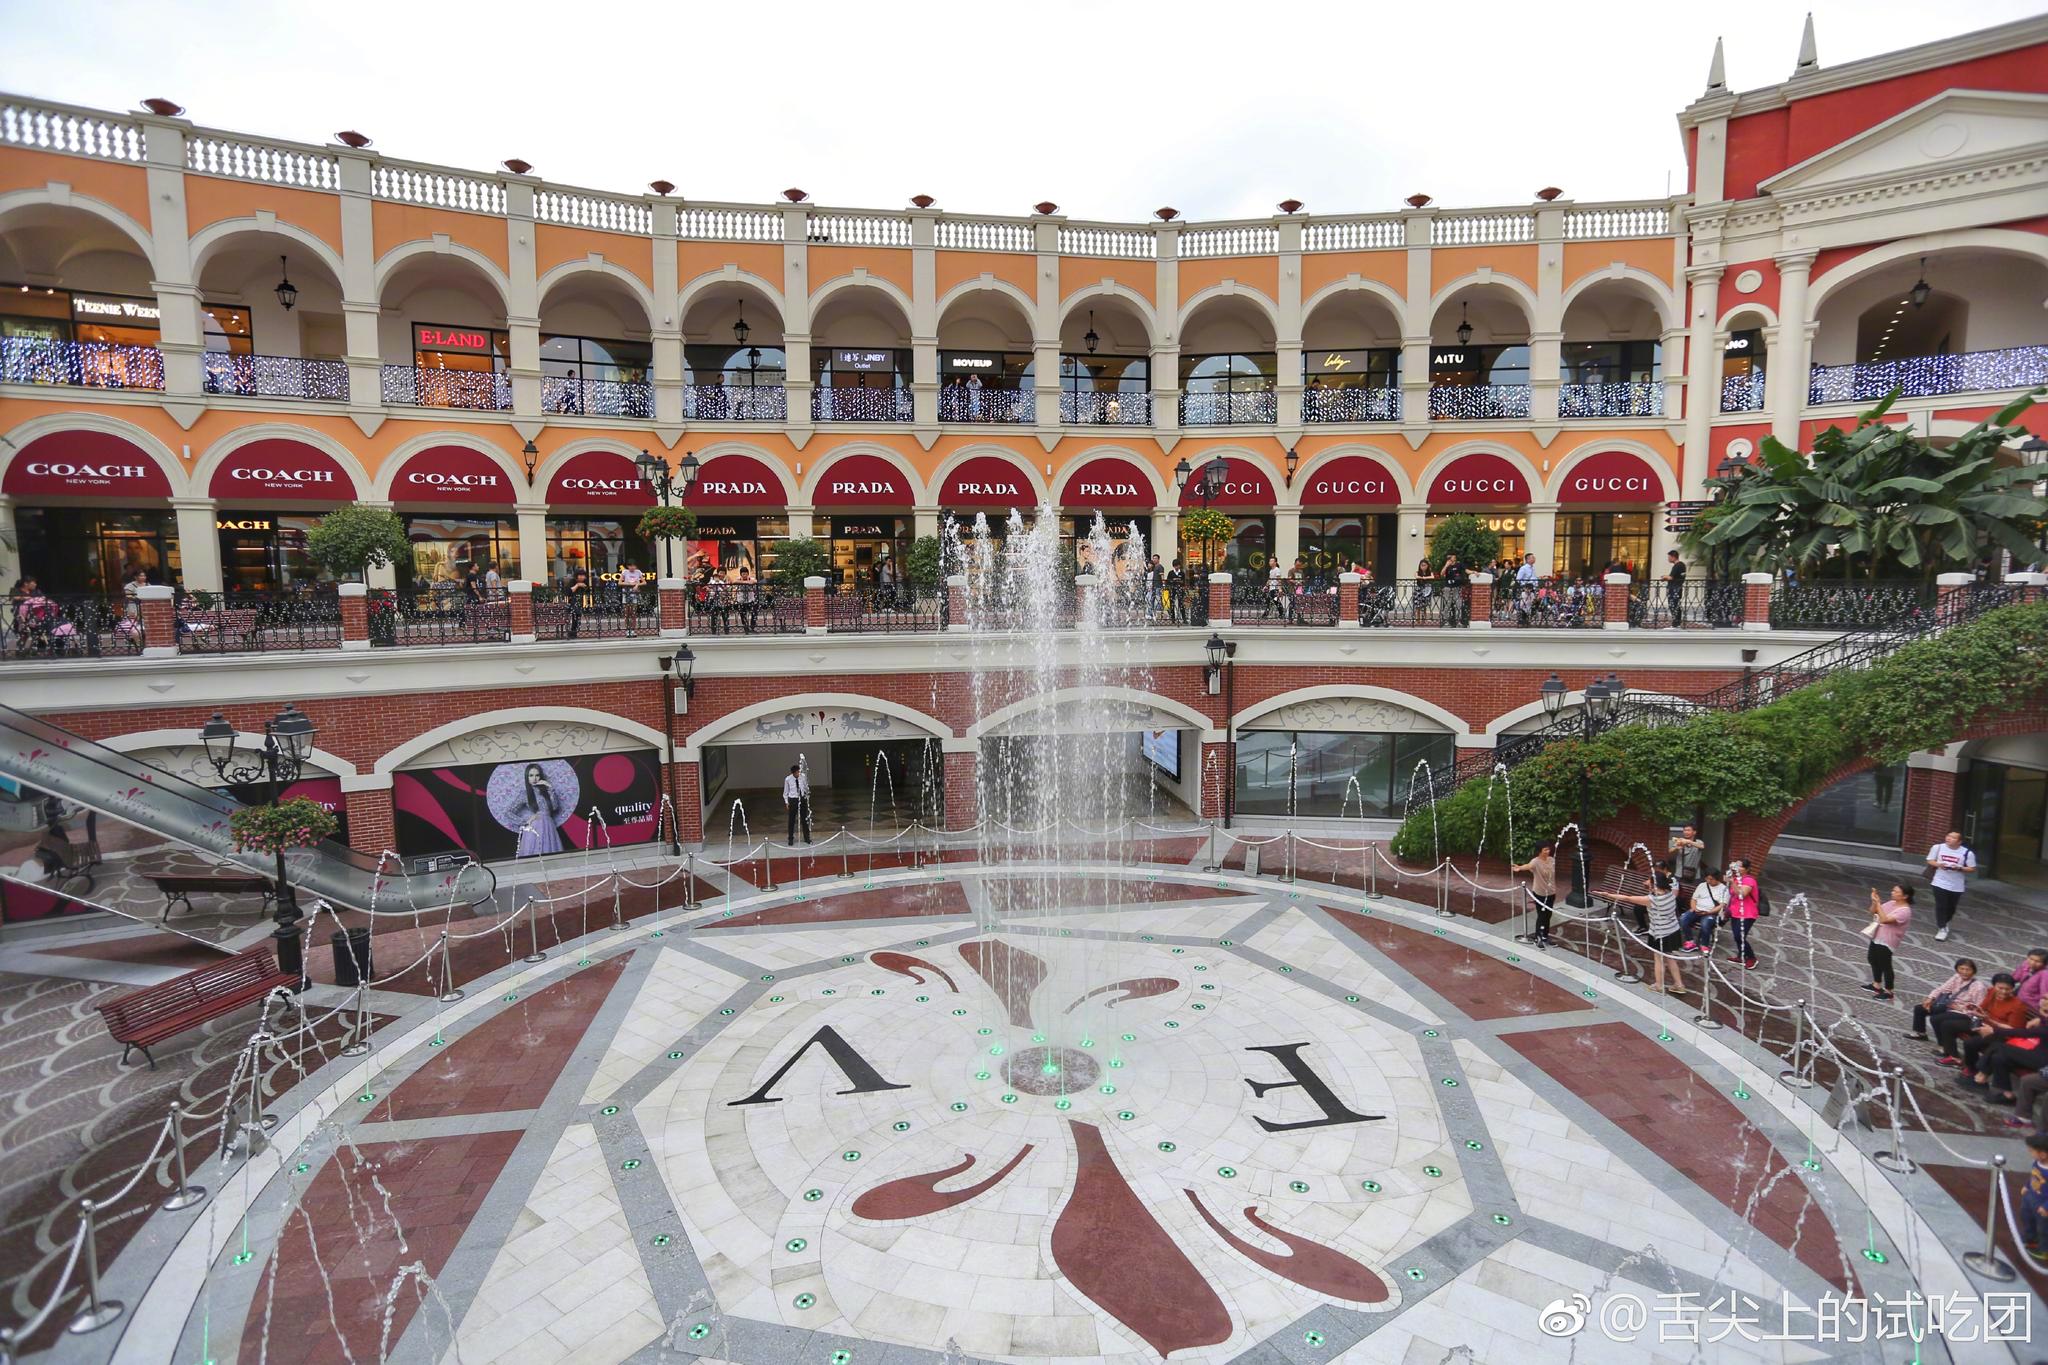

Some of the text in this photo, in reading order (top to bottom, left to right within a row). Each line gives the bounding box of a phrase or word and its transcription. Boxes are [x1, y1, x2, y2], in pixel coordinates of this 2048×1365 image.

[864, 354, 886, 362] JNBY
[952, 358, 993, 368] MOVEUP
[26, 463, 147, 478] COACH
[231, 468, 334, 482] COACH
[408, 473, 497, 486] COACH
[561, 479, 641, 490] COACH
[1444, 479, 1514, 492] GUCCI
[1575, 478, 1648, 491] GUCCI
[703, 482, 767, 494] PRADA
[832, 482, 894, 494] PRADA
[958, 483, 1018, 494] PRADA
[1080, 484, 1138, 495] PRADA
[1194, 482, 1260, 495] GCCI
[1316, 481, 1385, 494] GUCCI
[698, 527, 736, 535] PRADA
[844, 526, 882, 534] PRADA
[614, 801, 652, 815] quality
